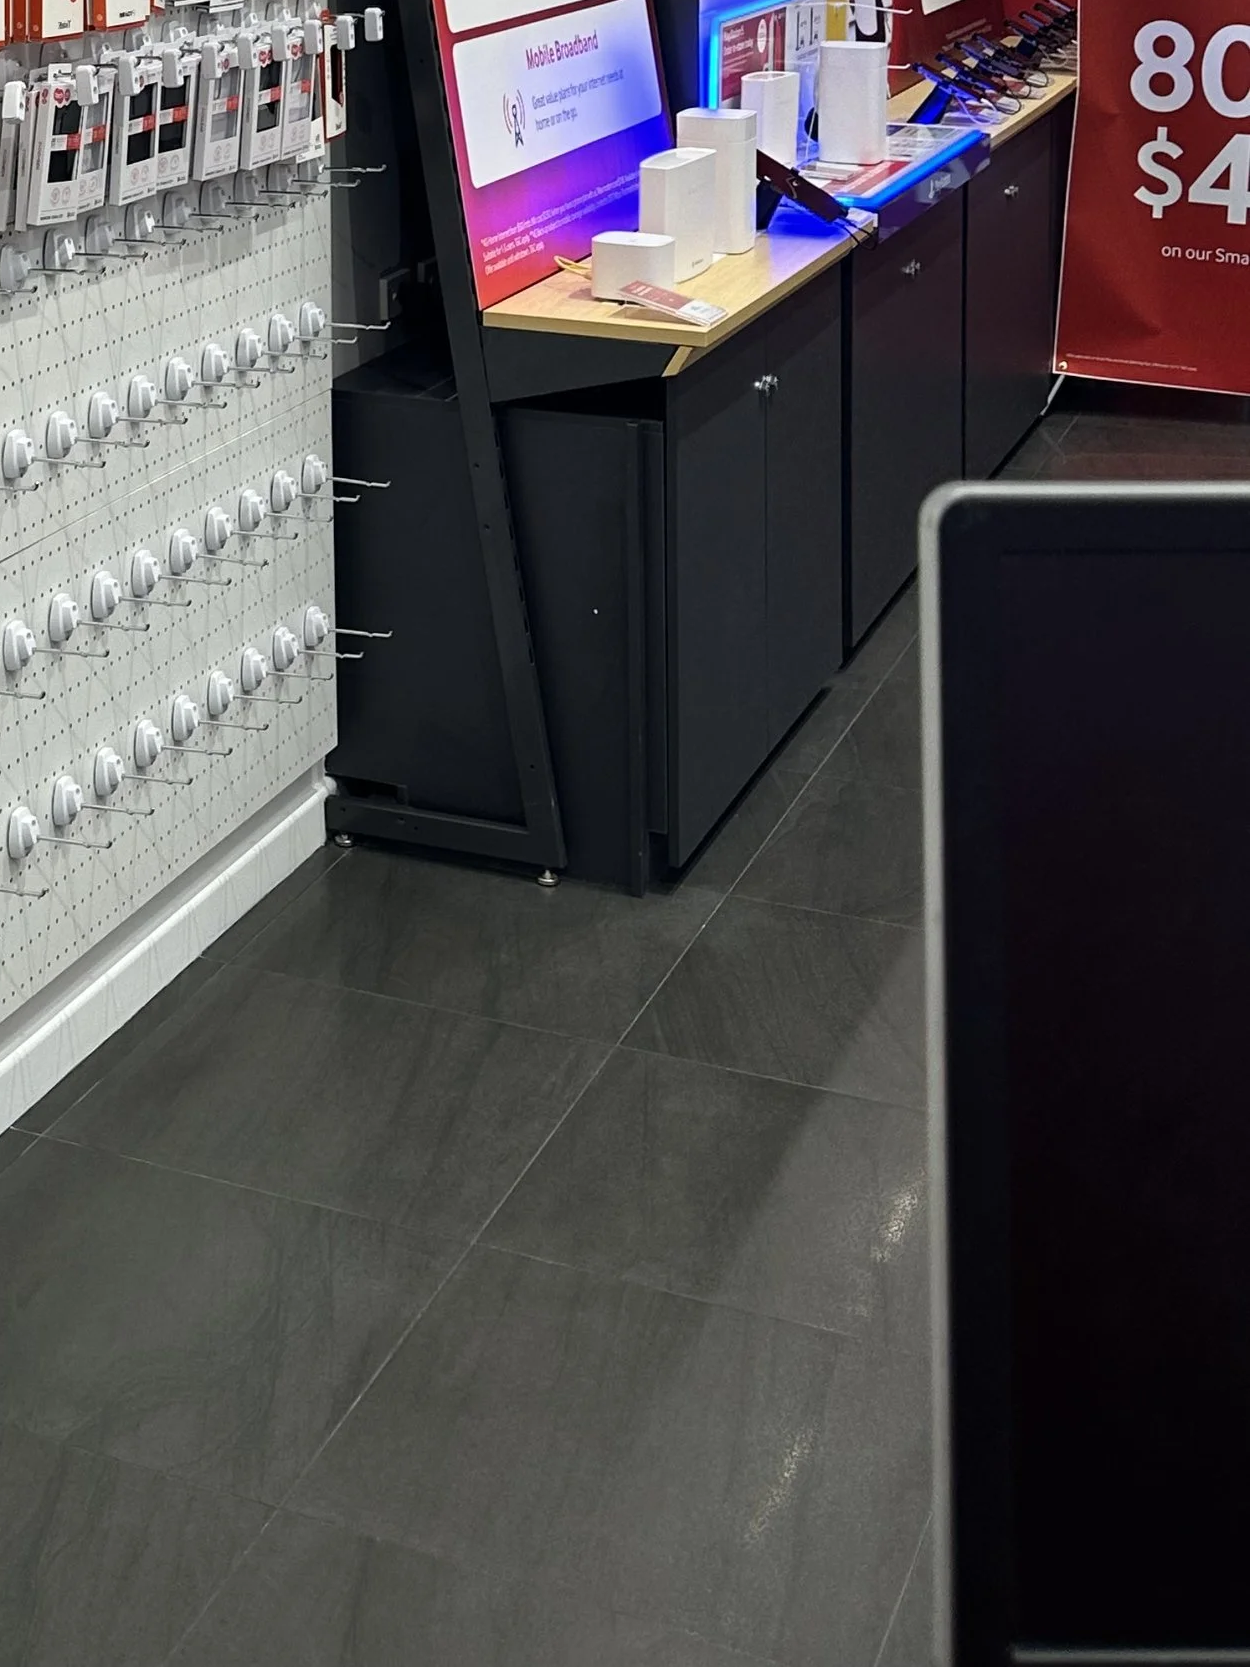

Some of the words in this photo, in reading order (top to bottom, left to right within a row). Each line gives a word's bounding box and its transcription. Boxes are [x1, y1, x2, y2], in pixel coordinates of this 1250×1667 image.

[525, 44, 555, 70] Mobile
[554, 30, 598, 61] Broadband
[1134, 127, 1250, 225] $4
[1161, 245, 1182, 258] on
[1185, 248, 1212, 261] our
[1215, 249, 1250, 265] Sma
